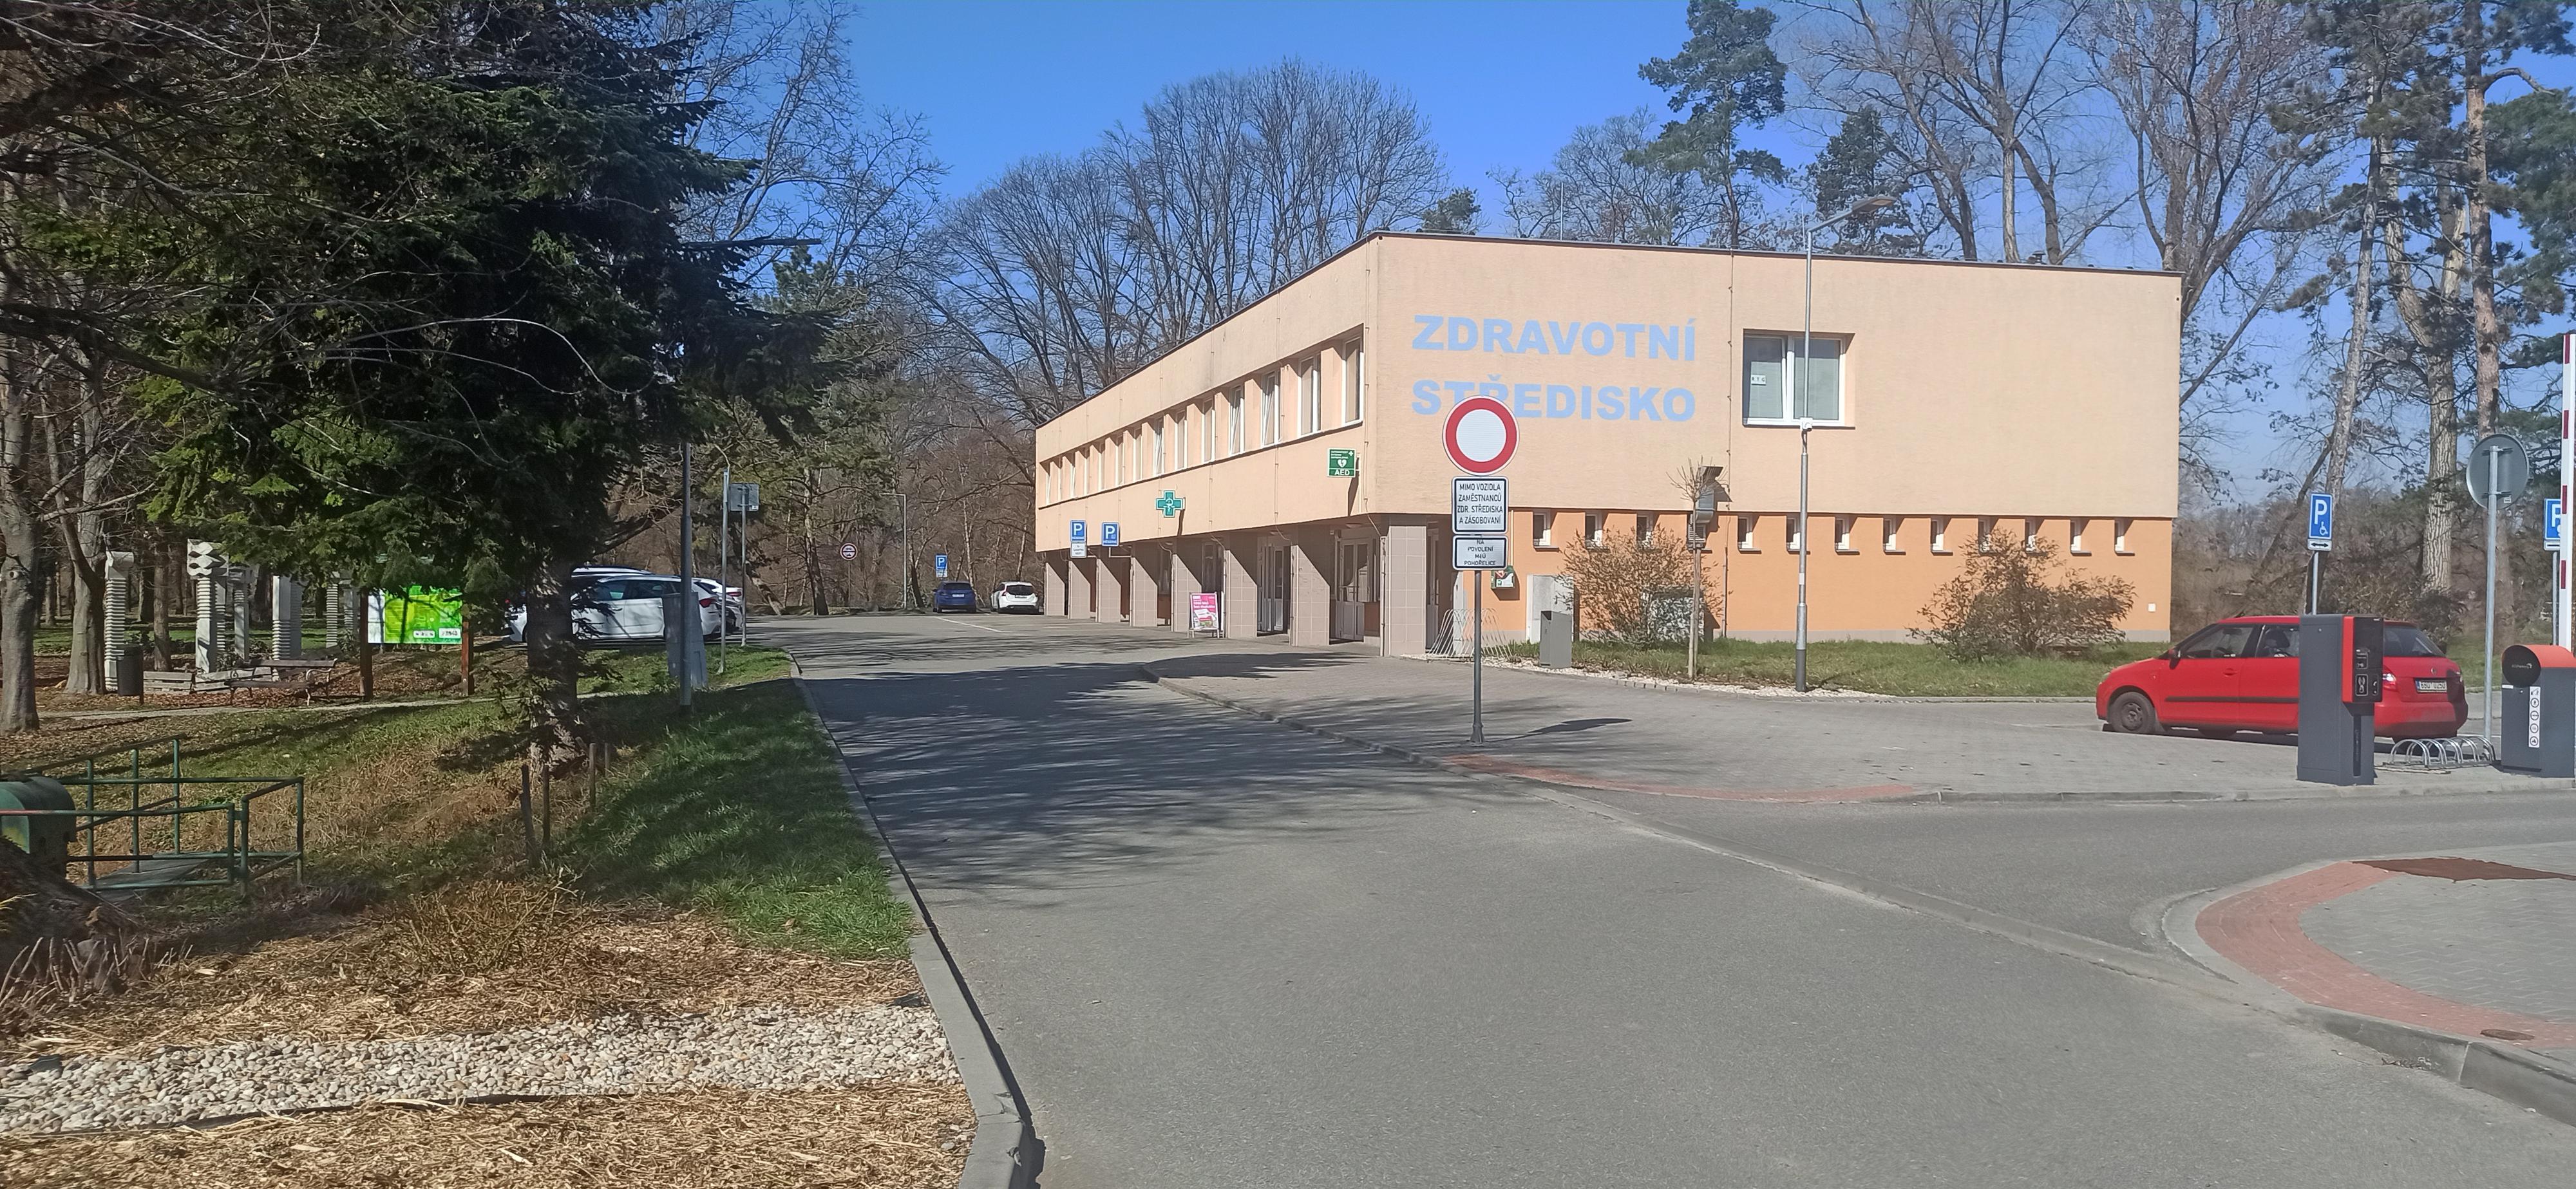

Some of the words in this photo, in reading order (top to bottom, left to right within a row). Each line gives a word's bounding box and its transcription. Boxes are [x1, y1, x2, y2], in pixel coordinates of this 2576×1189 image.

[1412, 314, 1696, 361] ZDRAVOTNÍ
[1459, 493, 1502, 501] ZAMĚSTNANCŮ
[1472, 504, 1503, 513] STŘEDISKA
[2314, 499, 2327, 525] P
[1074, 523, 1082, 536] P
[1105, 525, 1115, 539] P
[938, 557, 945, 566] P
